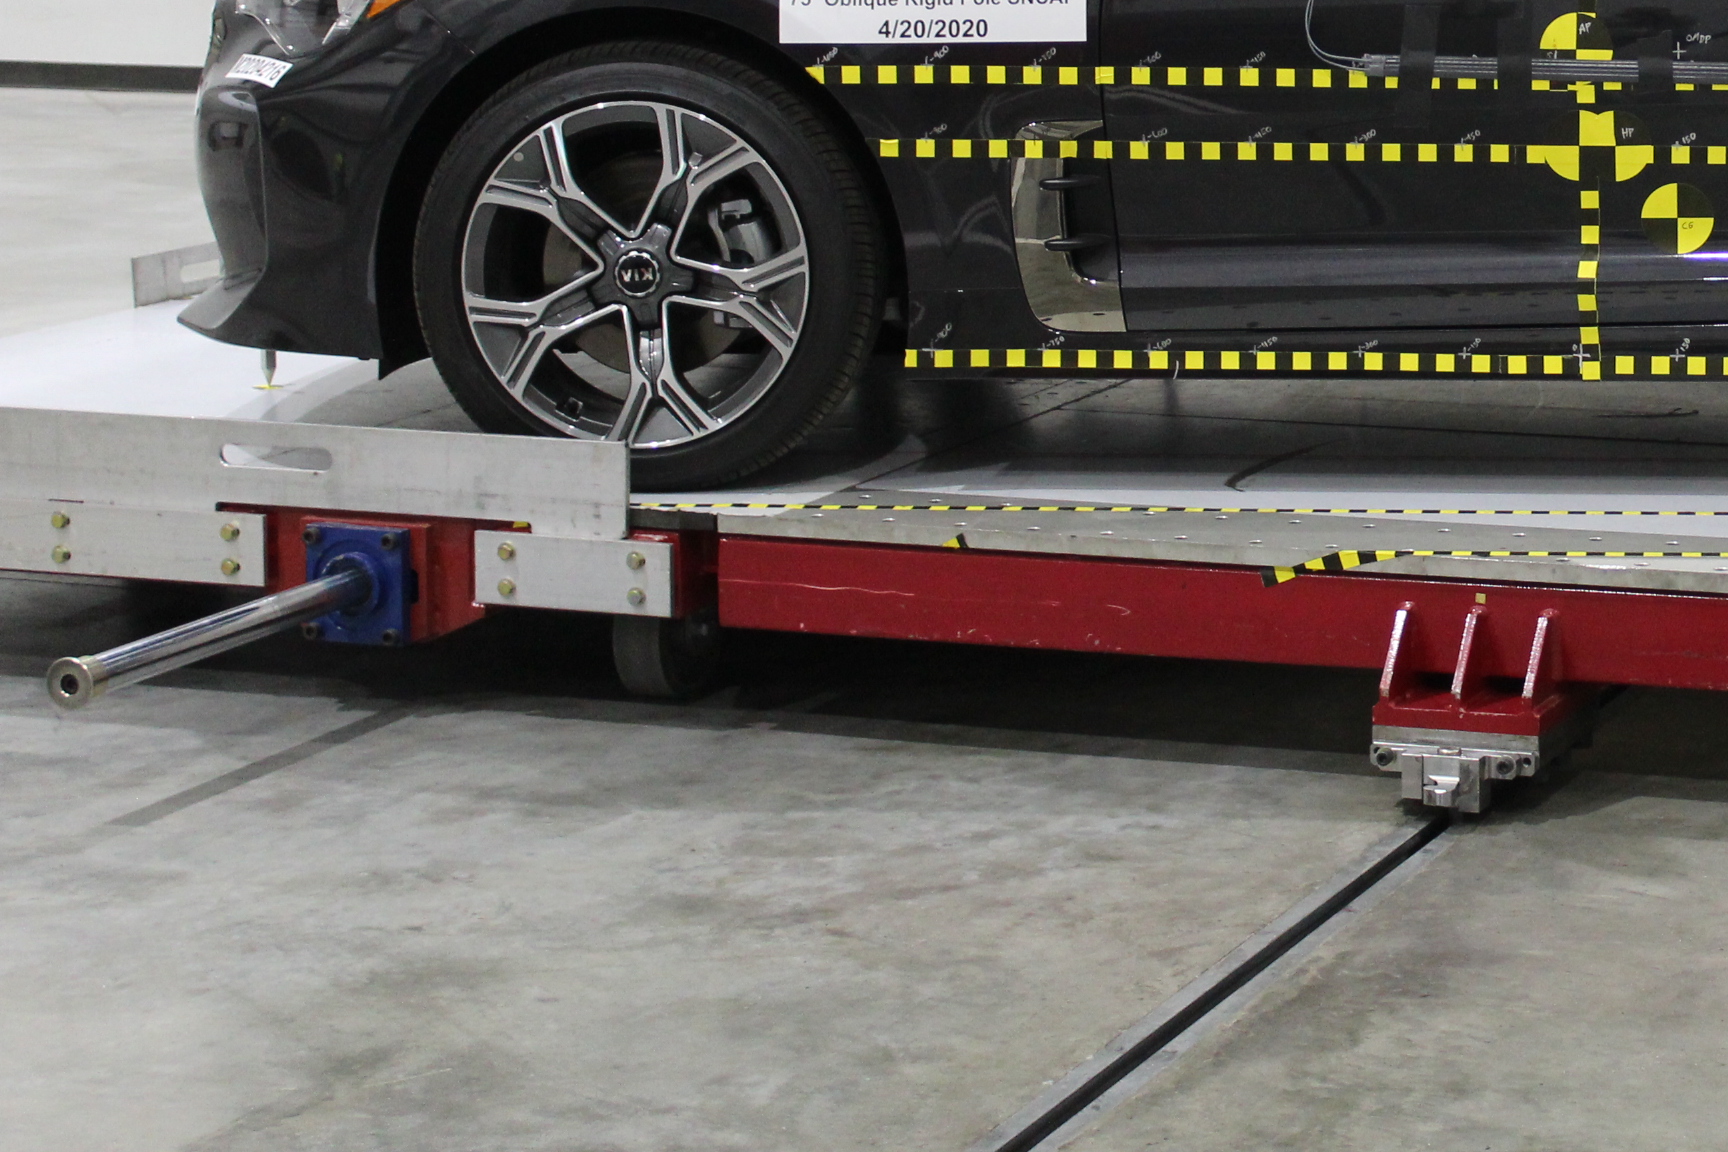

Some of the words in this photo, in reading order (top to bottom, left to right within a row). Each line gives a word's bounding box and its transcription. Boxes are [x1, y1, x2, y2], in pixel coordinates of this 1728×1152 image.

[878, 19, 988, 39] 4/20/2020
[1682, 132, 1697, 144] 150
[620, 268, 654, 282] KIA
